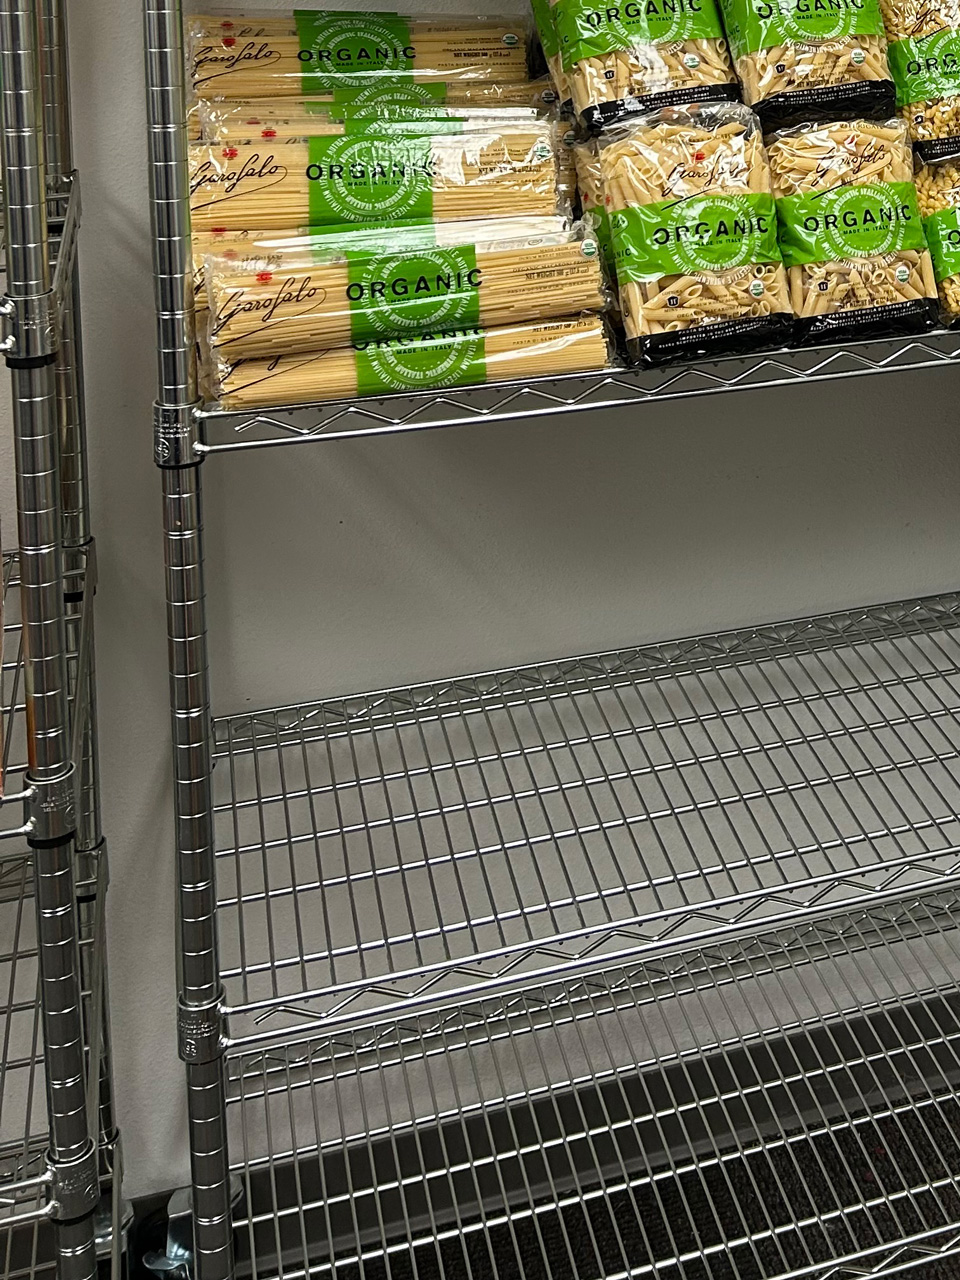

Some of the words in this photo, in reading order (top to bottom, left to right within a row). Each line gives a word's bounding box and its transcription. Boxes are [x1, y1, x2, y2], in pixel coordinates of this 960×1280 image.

[191, 41, 281, 79] Garofalo
[296, 46, 417, 62] ORGANIC
[190, 153, 287, 195] Garofalo
[305, 162, 438, 181] ORGANIC
[653, 217, 769, 246] ORGANIC
[803, 204, 912, 234] ORGANIC
[346, 268, 483, 301] ORGANIC
[211, 276, 327, 337] Garofalo
[432, 344, 452, 352] ITALY
